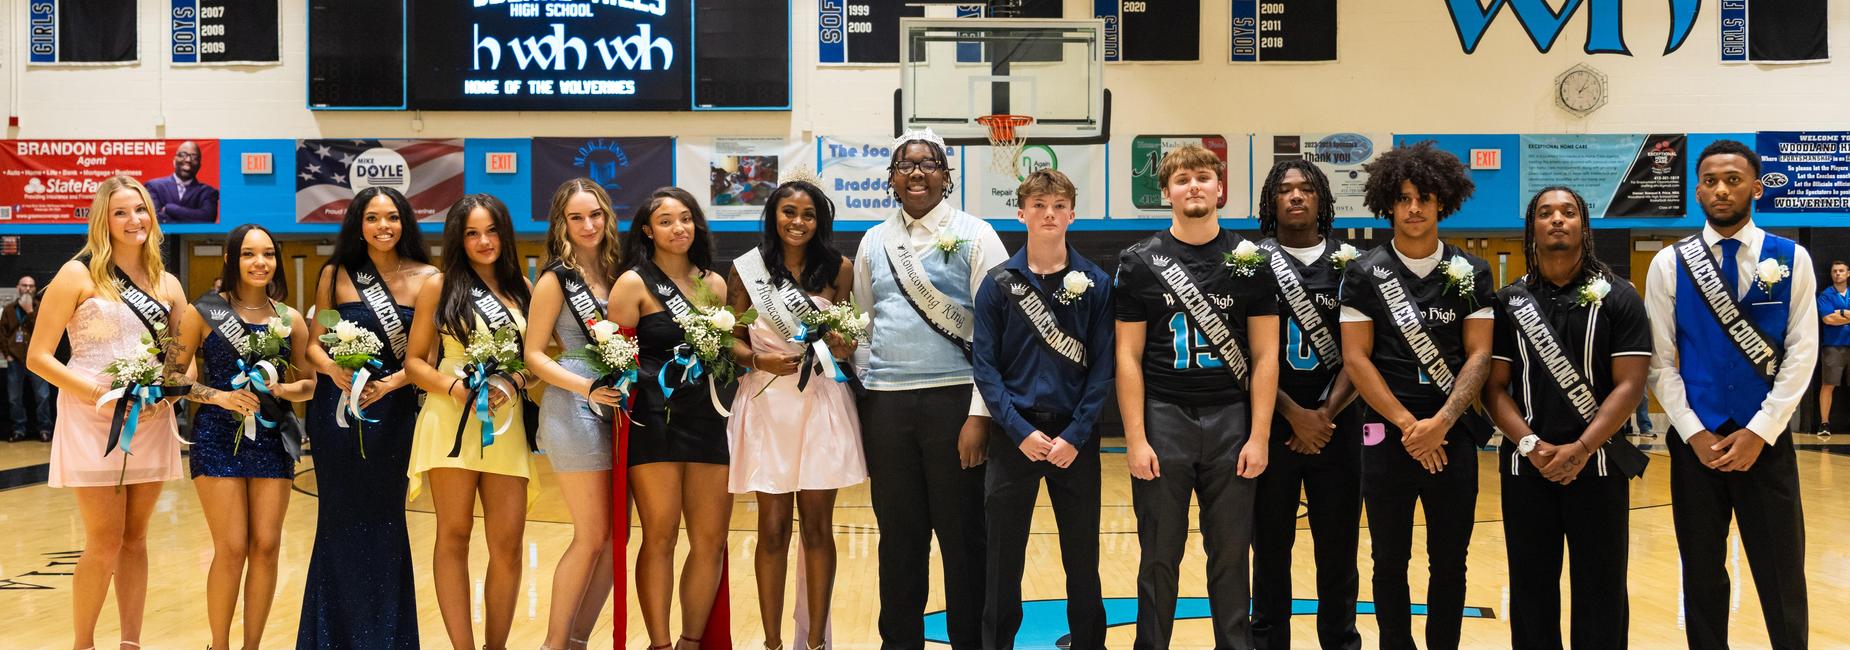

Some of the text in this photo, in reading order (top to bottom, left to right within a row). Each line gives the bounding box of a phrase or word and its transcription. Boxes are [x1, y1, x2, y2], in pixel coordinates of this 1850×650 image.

[201, 6, 225, 18] 2007
[510, 3, 540, 17] HIGH
[545, 3, 594, 17] SCHOOL
[848, 5, 870, 16] 1999
[1123, 2, 1146, 12] 2020
[1261, 3, 1284, 14] 2000
[32, 3, 54, 55] GIRLS
[173, 7, 195, 54] BOYS
[201, 24, 225, 36] 2008
[848, 22, 872, 33] 2000
[1261, 20, 1281, 31] 2011
[1233, 17, 1255, 55] BOYS
[1261, 37, 1283, 48] 2018
[1723, 18, 1744, 55] GIRLS
[201, 42, 226, 54] 2009
[507, 23, 588, 70] wh
[593, 23, 674, 70] wh
[464, 80, 636, 95] HOME OF THE WOLVERINES
[17, 142, 166, 155] BRANDON GREENE
[829, 144, 892, 157] The Soa
[1779, 143, 1837, 153] WOODLAND
[76, 156, 106, 166] Agent
[247, 155, 267, 170] EXIT
[491, 154, 511, 169] EXIT
[1304, 152, 1351, 163] Thank you
[1476, 151, 1497, 167] EXIT
[357, 165, 403, 177] DOYLE
[992, 188, 1013, 196] Repair
[846, 196, 902, 208] Laundr
[1774, 197, 1840, 208] WOLVERINE
[899, 250, 965, 328] Homecoming King
[1680, 238, 1774, 365] HOMECOMING COURT
[1161, 263, 1249, 380] HOMECOMING COURT
[1378, 277, 1439, 365] HOMECOMING
[1428, 307, 1456, 323] High
[1019, 291, 1084, 363] HOMECOMING
[218, 316, 246, 355] HOM
[1310, 326, 1343, 370] COURT
[1513, 303, 1580, 389] HOMECOMING
